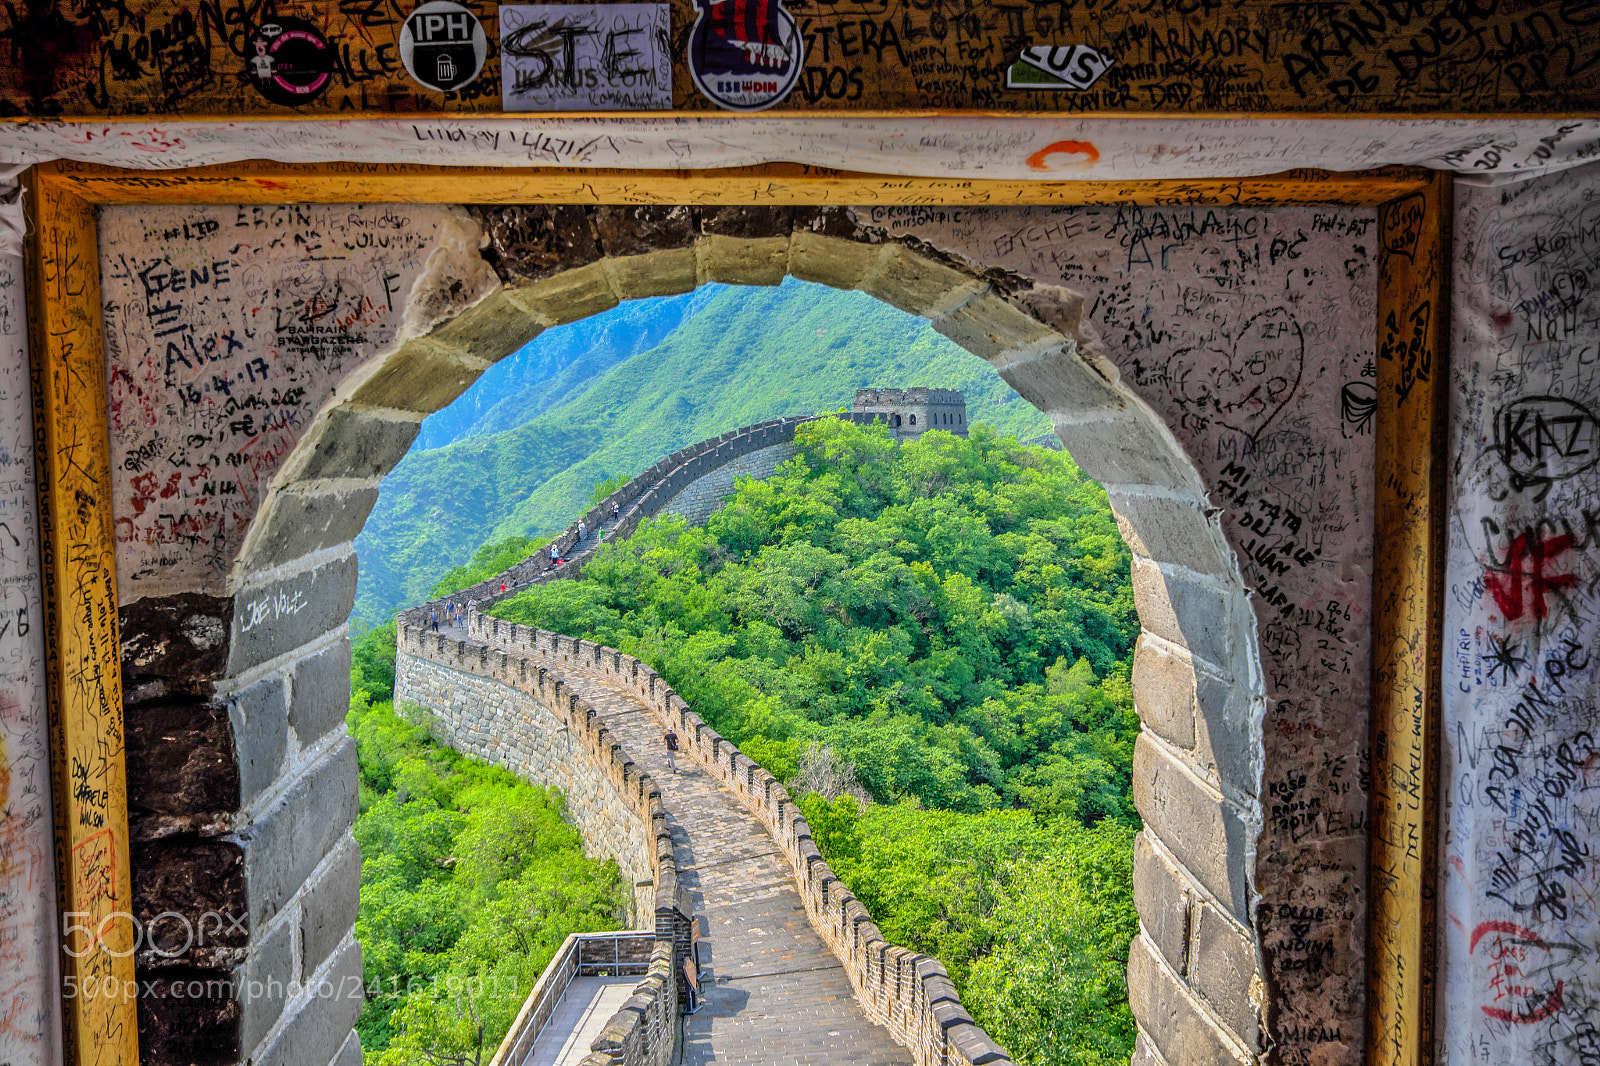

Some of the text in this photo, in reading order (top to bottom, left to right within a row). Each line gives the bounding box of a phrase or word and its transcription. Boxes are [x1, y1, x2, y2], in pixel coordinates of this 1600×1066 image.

[414, 13, 468, 41] IPH
[905, 46, 947, 65] HAPPY
[288, 326, 347, 334] BAHRAIN
[278, 337, 364, 345] STARGAZERS
[165, 330, 244, 376] Alex
[240, 595, 270, 632] JOE
[1282, 1026, 1342, 1043] MICAH
